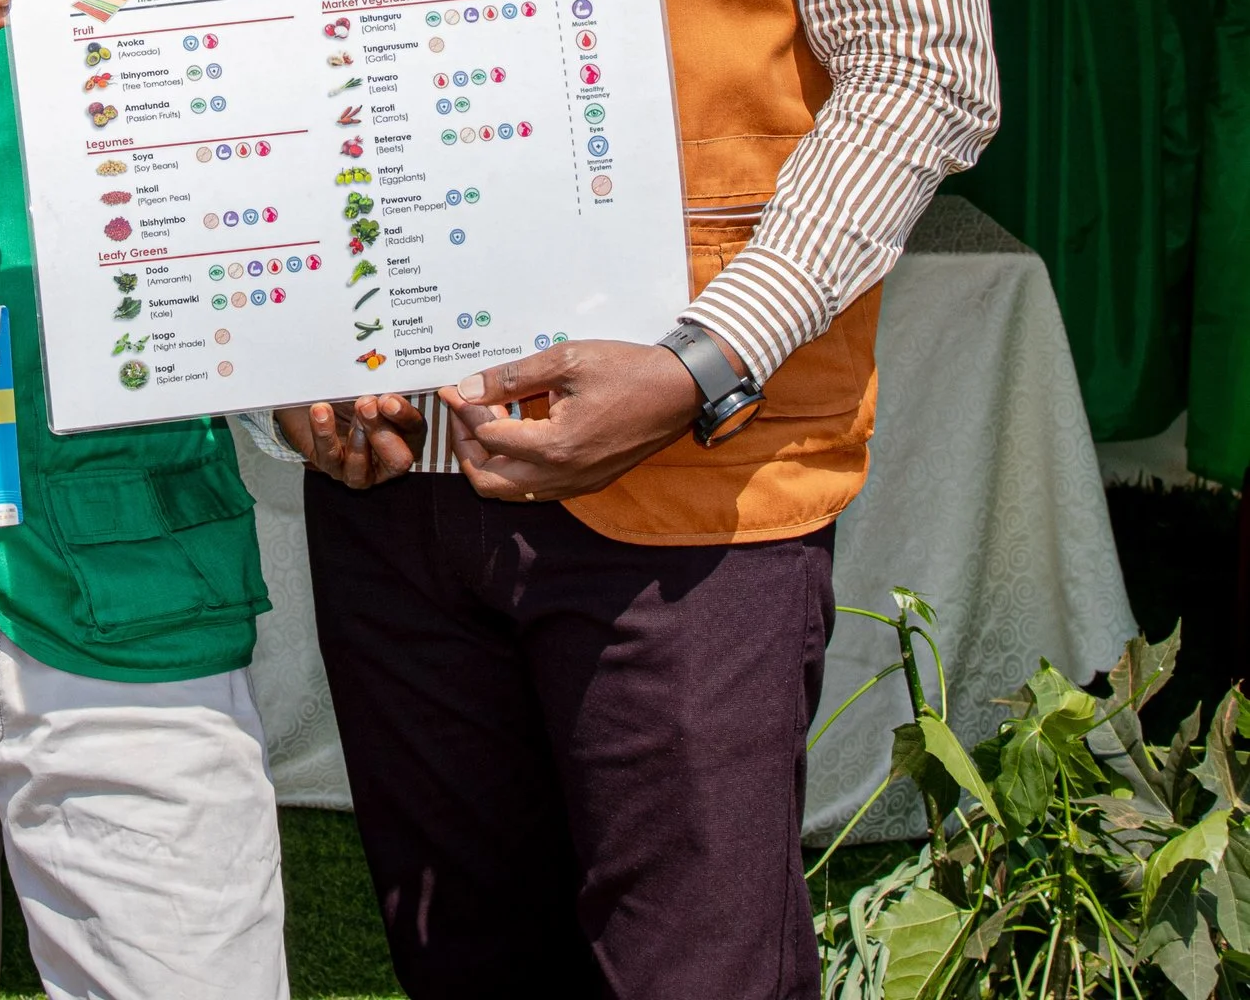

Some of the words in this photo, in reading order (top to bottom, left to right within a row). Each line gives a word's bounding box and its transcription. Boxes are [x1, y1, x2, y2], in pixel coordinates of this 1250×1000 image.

[73, 26, 94, 36] Fruit
[361, 23, 397, 34] (Onions)
[117, 38, 145, 48] Avoka
[363, 41, 419, 53] Tungurusumu
[118, 47, 161, 59] (Avocado)
[365, 53, 396, 64] (Garlic)
[120, 69, 169, 82] Ibinyomoro
[367, 74, 399, 83] Puwaro
[122, 82, 141, 92] (Tree
[143, 78, 184, 89] Tomatoes)
[368, 83, 398, 94] (Leeks)
[576, 92, 611, 100] Pregnancy
[124, 101, 170, 112] Amatunda
[371, 104, 395, 113] Karoti
[126, 113, 158, 124] (Passion
[159, 110, 181, 121] Fruits)
[372, 113, 409, 125] (Carrots)
[86, 137, 134, 150] Legumes
[374, 133, 412, 144] Beterave
[376, 144, 404, 155] (Beets)
[132, 153, 154, 162] Soya
[134, 164, 151, 174] (Soy
[152, 161, 179, 171] Beans)
[589, 164, 612, 172] System
[379, 172, 426, 185] (Eggplants)
[137, 196, 168, 207] (Pigeon
[169, 193, 191, 203] Peas)
[381, 194, 422, 205] Puwavuro
[382, 205, 412, 216] (Green
[414, 201, 447, 213] Pepper)
[141, 229, 170, 239] (Beans)
[384, 226, 403, 235] Radi
[385, 234, 424, 246] (Raddish)
[98, 249, 127, 261] Leafy
[129, 246, 168, 258] Greens
[146, 266, 169, 275] Dodo
[388, 265, 421, 277] (Celery)
[147, 274, 192, 287] (Amaranth)
[389, 285, 438, 296] Kokombure
[148, 295, 200, 308] Sukumawiki
[390, 294, 442, 307] (Cucumber)
[150, 309, 173, 319] (Kale)
[152, 332, 175, 342] Isogo
[393, 325, 433, 338] (Zucchini)
[153, 342, 177, 352] (Night
[178, 339, 206, 349] shade)
[394, 346, 432, 358] Ibijumba
[433, 344, 450, 354] bya
[451, 340, 481, 350] Oranje
[396, 357, 431, 369] (Orange
[433, 354, 453, 363] Flesh
[455, 351, 481, 361] Sweet
[482, 345, 522, 357] Potatoes)
[155, 364, 175, 374] Isogi
[156, 374, 183, 385] (Spider
[185, 371, 209, 382] plant)
